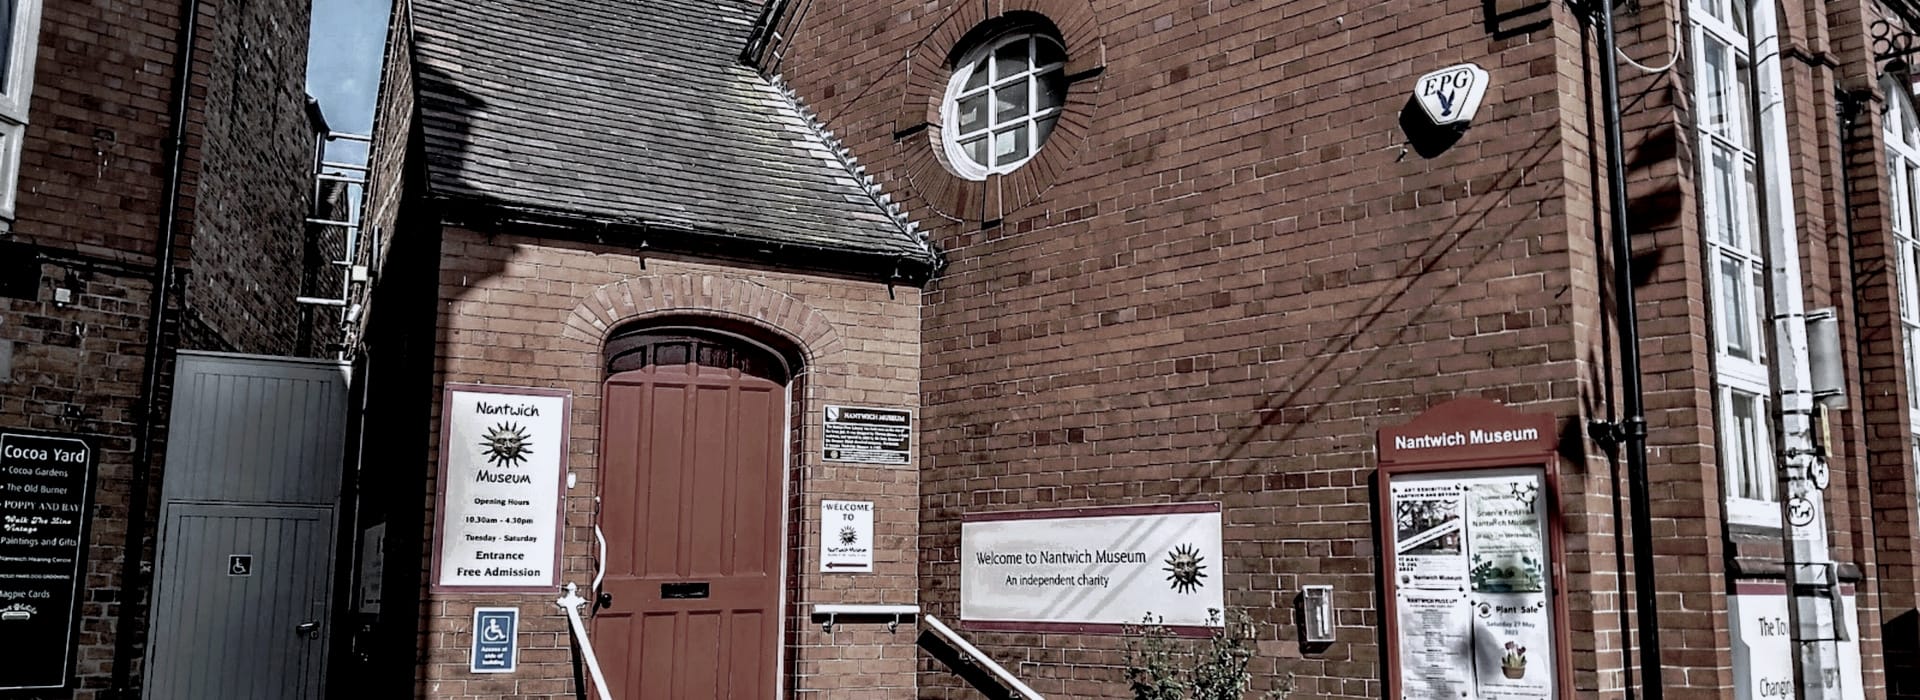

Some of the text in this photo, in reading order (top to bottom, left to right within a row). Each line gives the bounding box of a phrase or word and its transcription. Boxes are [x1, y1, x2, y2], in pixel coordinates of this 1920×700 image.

[1424, 70, 1468, 96] EPG
[476, 401, 539, 416] Nantwich
[1395, 428, 1538, 450] Nantwich Museum
[4, 444, 85, 463] Cocoa Yard
[8, 465, 68, 478] Cocoa Gardens
[476, 469, 531, 484] Museum
[7, 483, 68, 495] The Old Burner
[4, 500, 35, 510] POPPY
[39, 502, 60, 512] AND
[474, 498, 506, 506] Opening
[31, 516, 48, 524] The
[465, 516, 498, 524] 10.30am
[505, 517, 534, 525] 4.30pm
[843, 513, 855, 521] TO
[0, 536, 77, 548] Paintings and Gifts
[465, 534, 496, 542] Tuesday
[504, 535, 537, 543] Saturday
[475, 550, 525, 560] Entrance
[976, 549, 1146, 565] Welcome to Nantwich Museum
[457, 567, 541, 577] Free Admission
[1005, 573, 1110, 588] An independent charity
[28, 590, 50, 599] Cards
[1496, 606, 1538, 614] Plant Sale
[1758, 616, 1790, 636] The To
